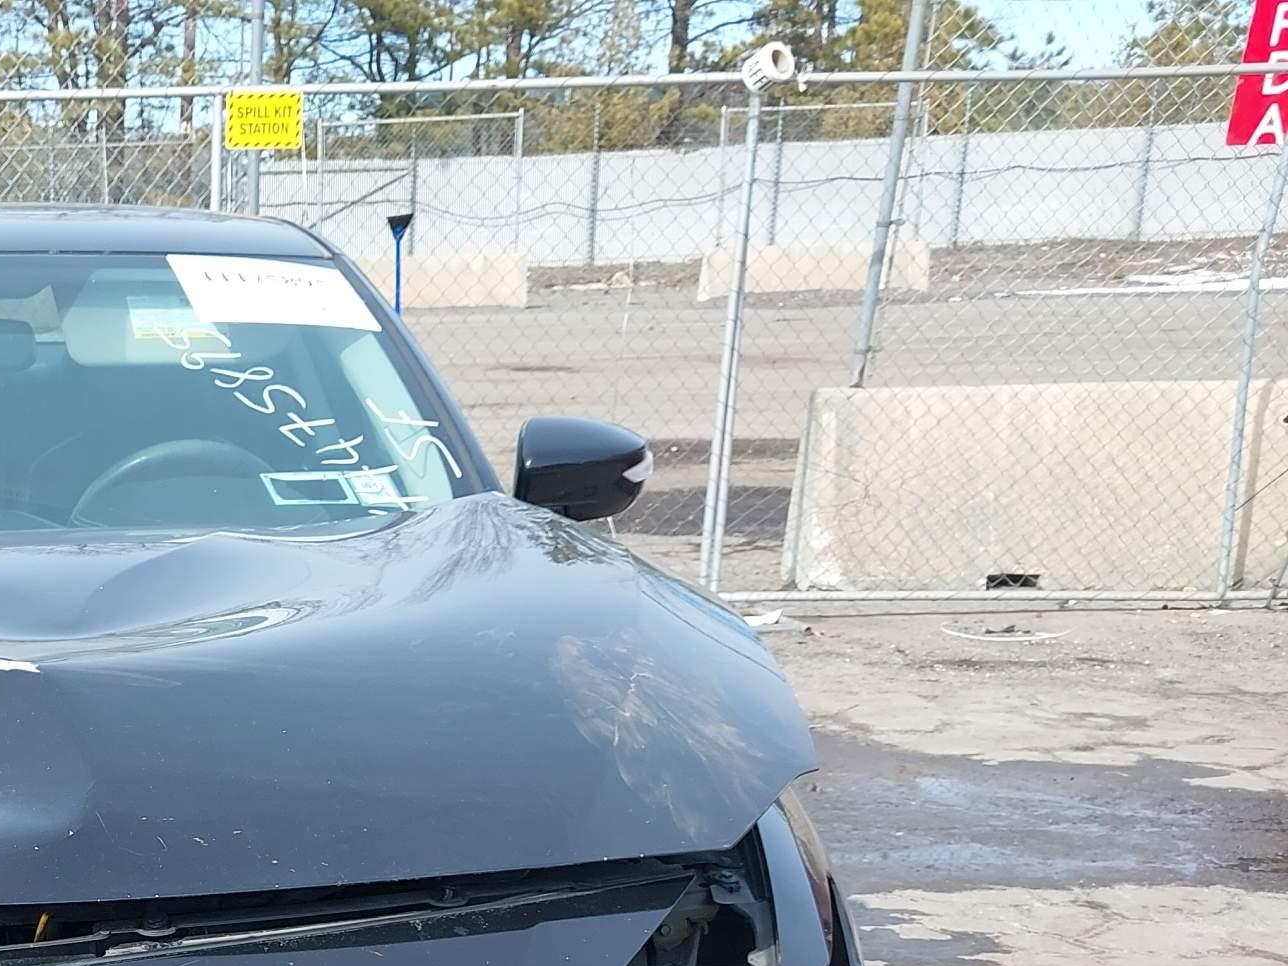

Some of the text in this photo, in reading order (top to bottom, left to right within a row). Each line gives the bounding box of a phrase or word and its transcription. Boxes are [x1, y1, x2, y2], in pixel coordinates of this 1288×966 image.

[237, 105, 293, 119] SPILL KIT
[239, 122, 289, 135] STATION
